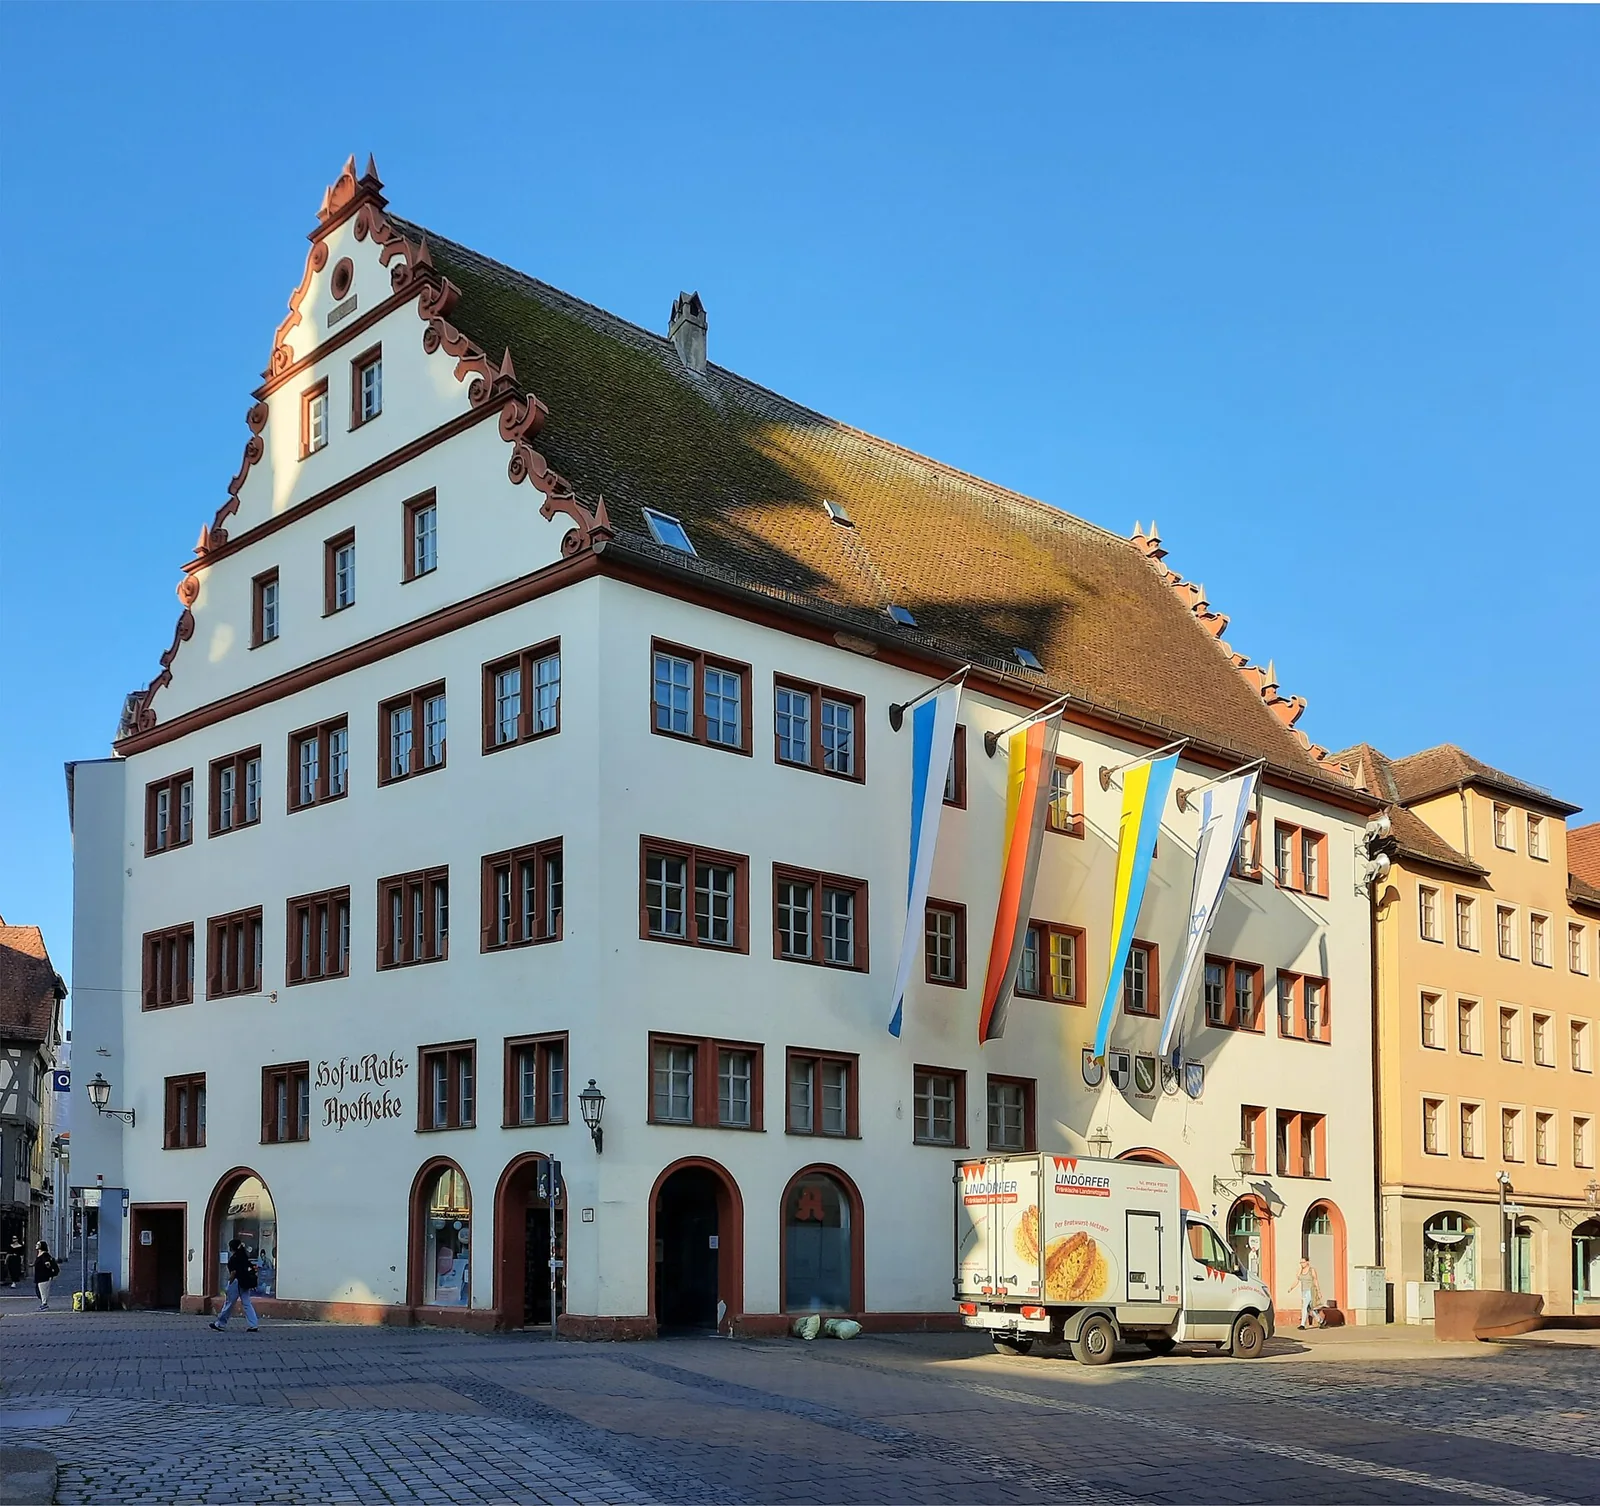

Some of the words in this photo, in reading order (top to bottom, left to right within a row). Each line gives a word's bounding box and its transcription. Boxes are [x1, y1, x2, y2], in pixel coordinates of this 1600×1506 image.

[322, 1090, 402, 1133] Apotheke
[1055, 1173, 1110, 1188] LINDÖRFER
[1055, 1221, 1064, 1229] Der
